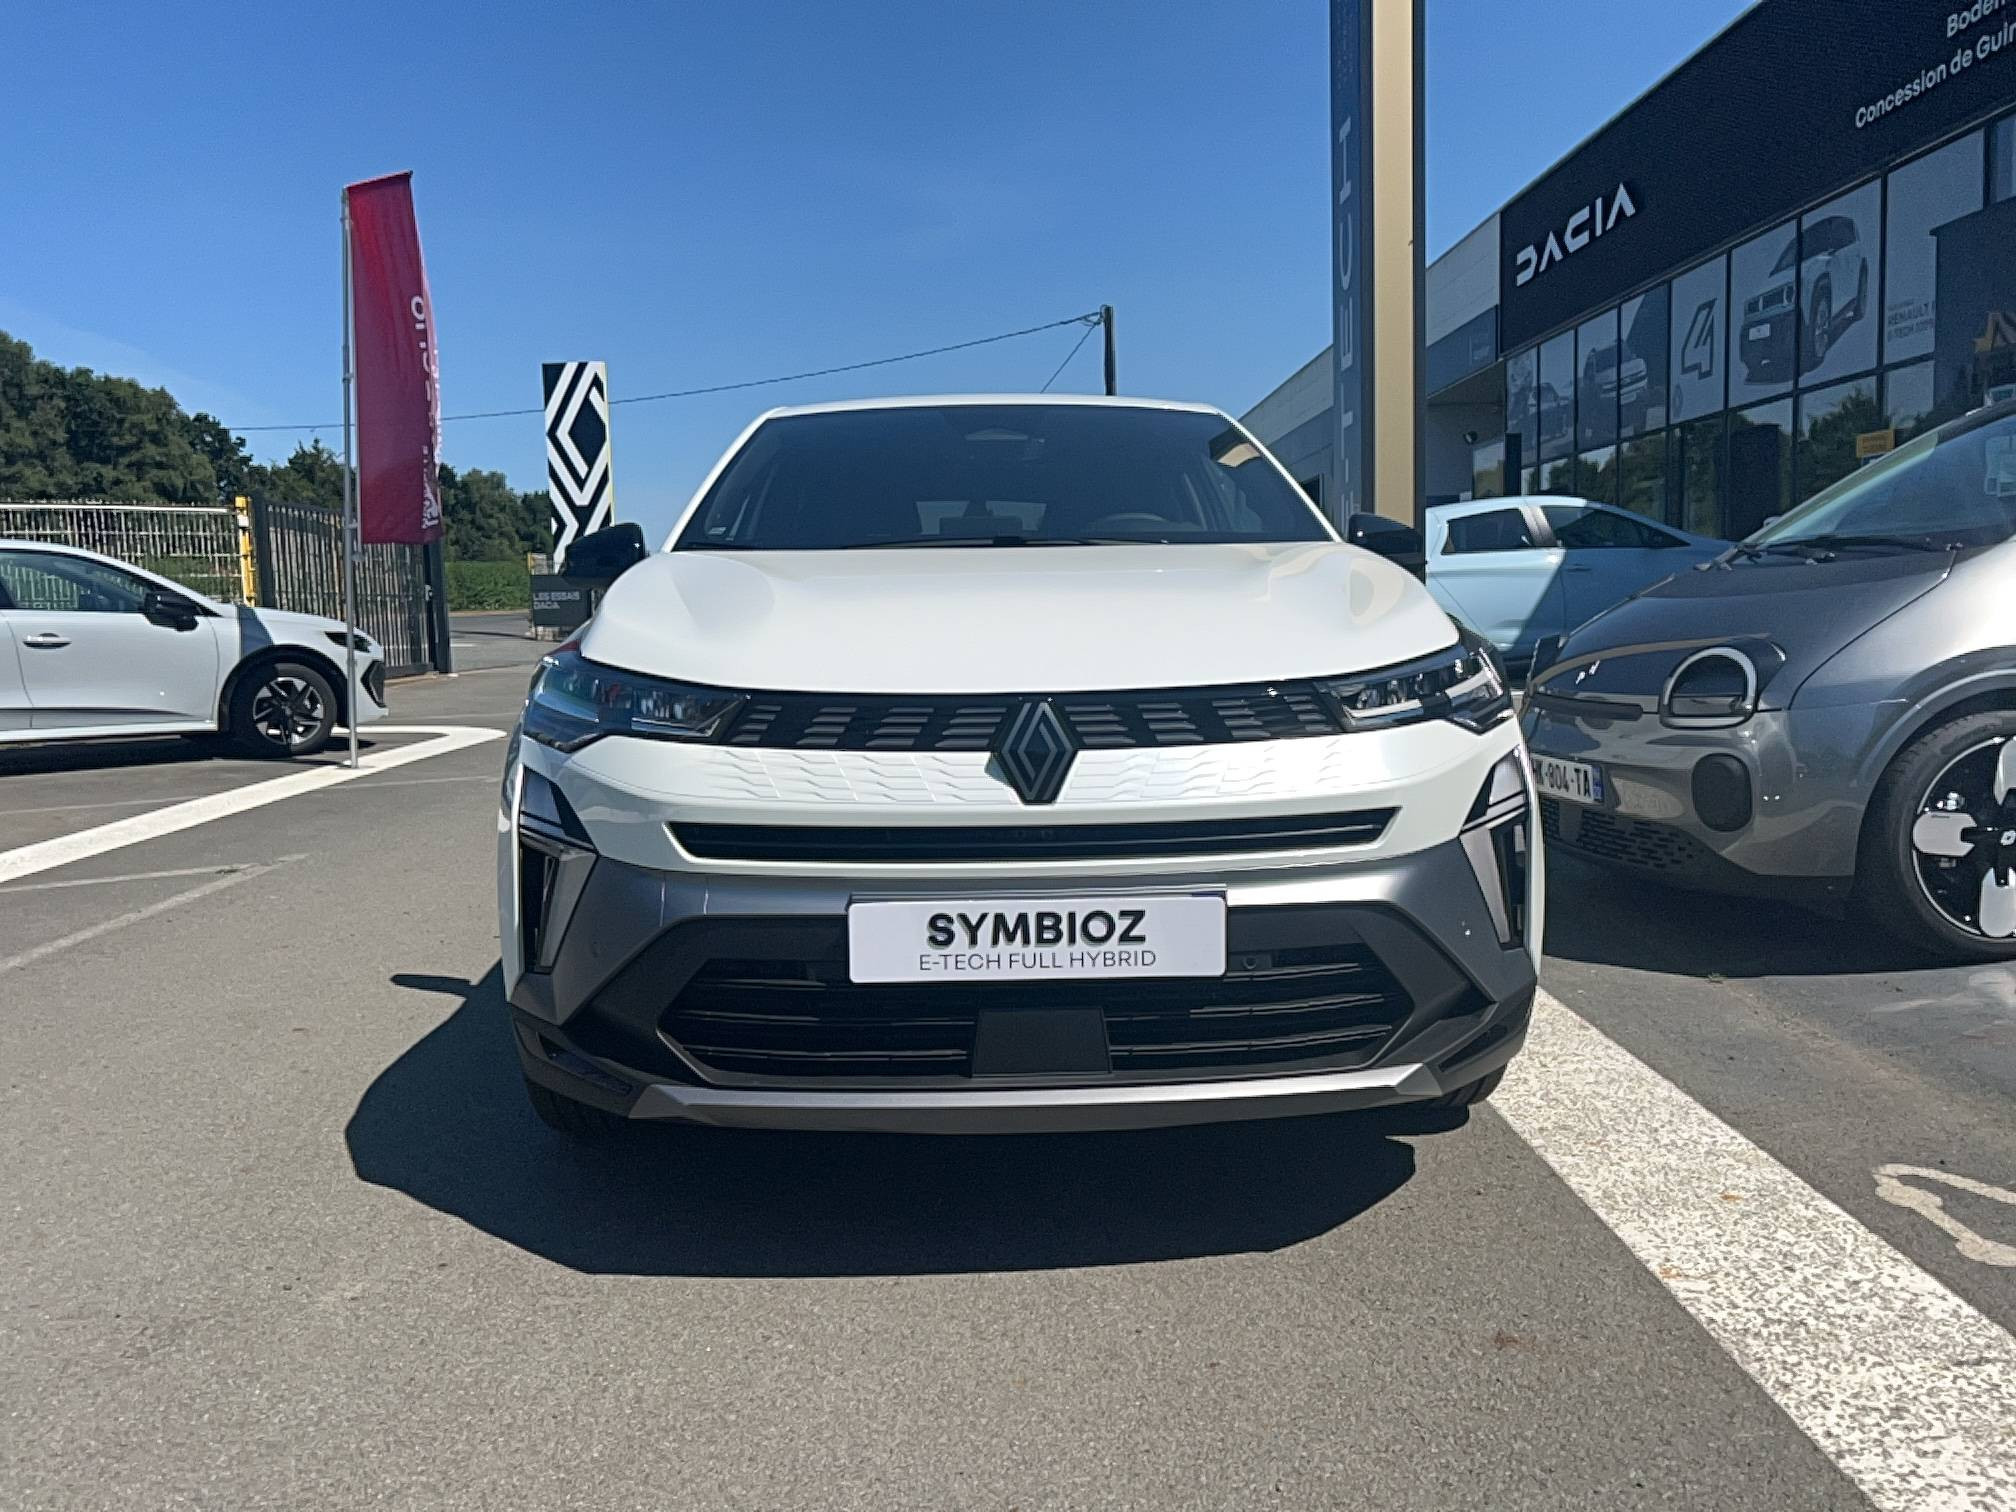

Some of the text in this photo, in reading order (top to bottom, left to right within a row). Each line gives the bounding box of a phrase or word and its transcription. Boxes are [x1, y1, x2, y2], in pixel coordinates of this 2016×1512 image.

[1855, 64, 1947, 128] Concession
[1950, 48, 1973, 75] de
[1516, 182, 1636, 287] DACIA
[1680, 297, 1718, 380] 4
[919, 950, 1157, 971] E-TECH FULL HYBRID
[926, 909, 1147, 949] SYMBIOZ
